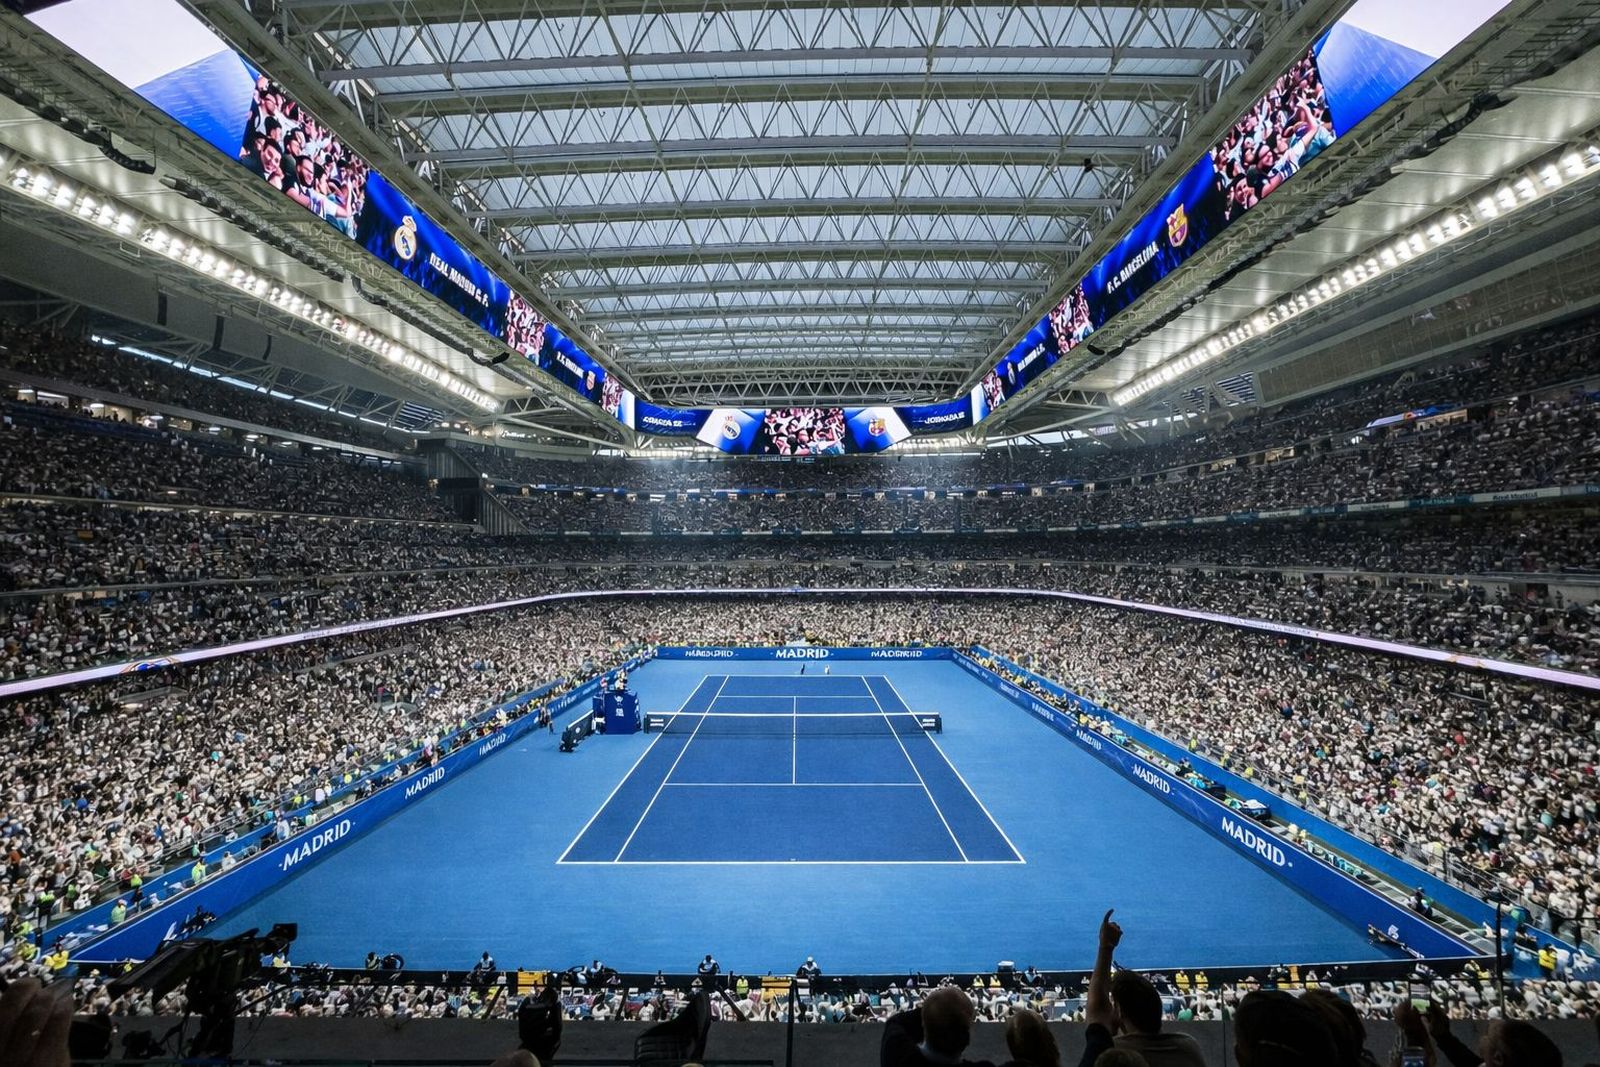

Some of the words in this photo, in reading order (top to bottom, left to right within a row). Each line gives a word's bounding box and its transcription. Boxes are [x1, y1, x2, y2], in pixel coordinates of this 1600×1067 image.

[775, 648, 829, 659] MADRID
[1132, 763, 1170, 794] MADRID
[282, 819, 351, 872] MADRID
[1221, 816, 1286, 867] MADRID
